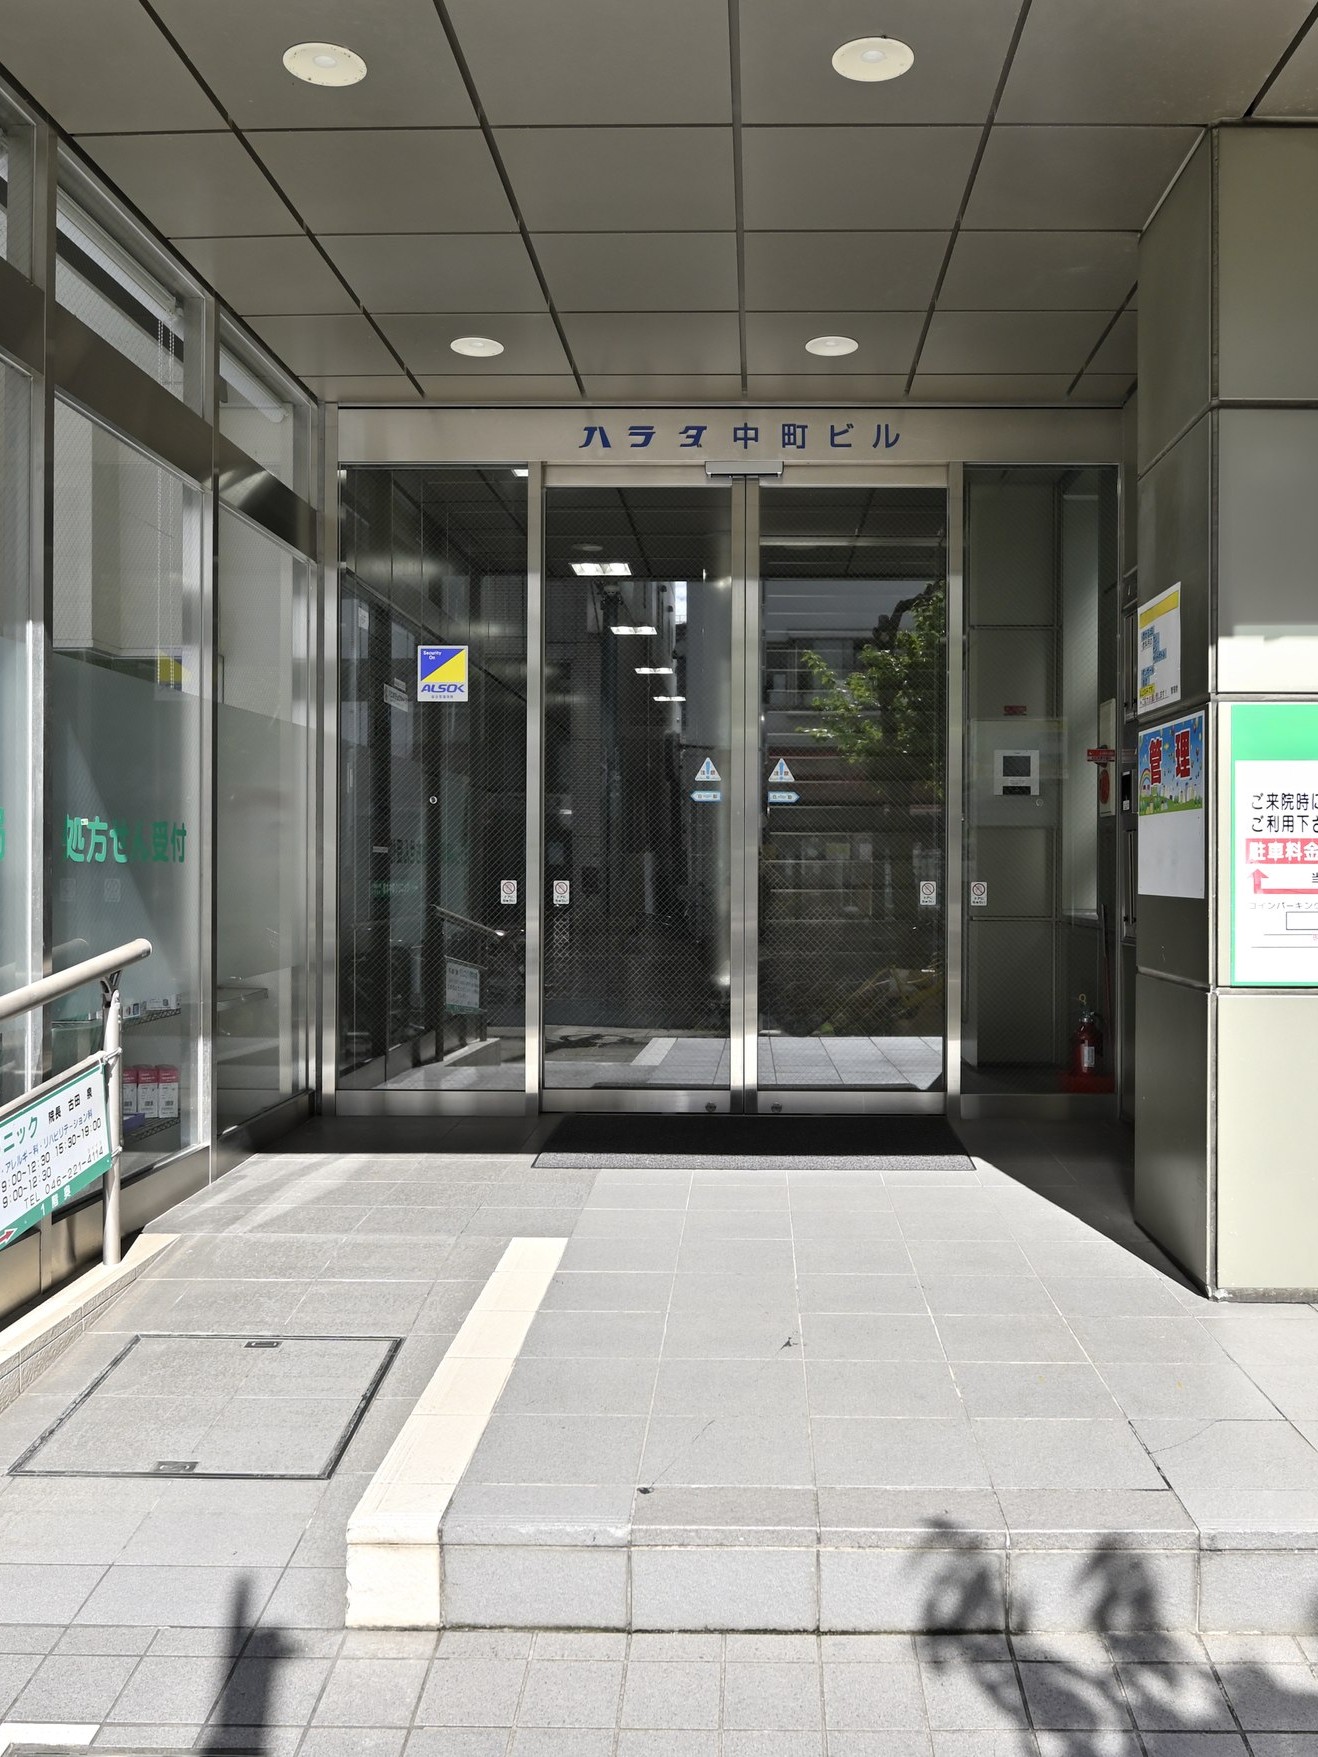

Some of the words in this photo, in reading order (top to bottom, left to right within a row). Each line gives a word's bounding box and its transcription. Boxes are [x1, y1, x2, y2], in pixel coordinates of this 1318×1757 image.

[579, 422, 900, 450] ハラダ中町ビル
[421, 684, 465, 693] ALSOK
[64, 815, 187, 863] 処方せん受付
[48, 1105, 62, 1124] 院長
[24, 1191, 41, 1209] TEL
